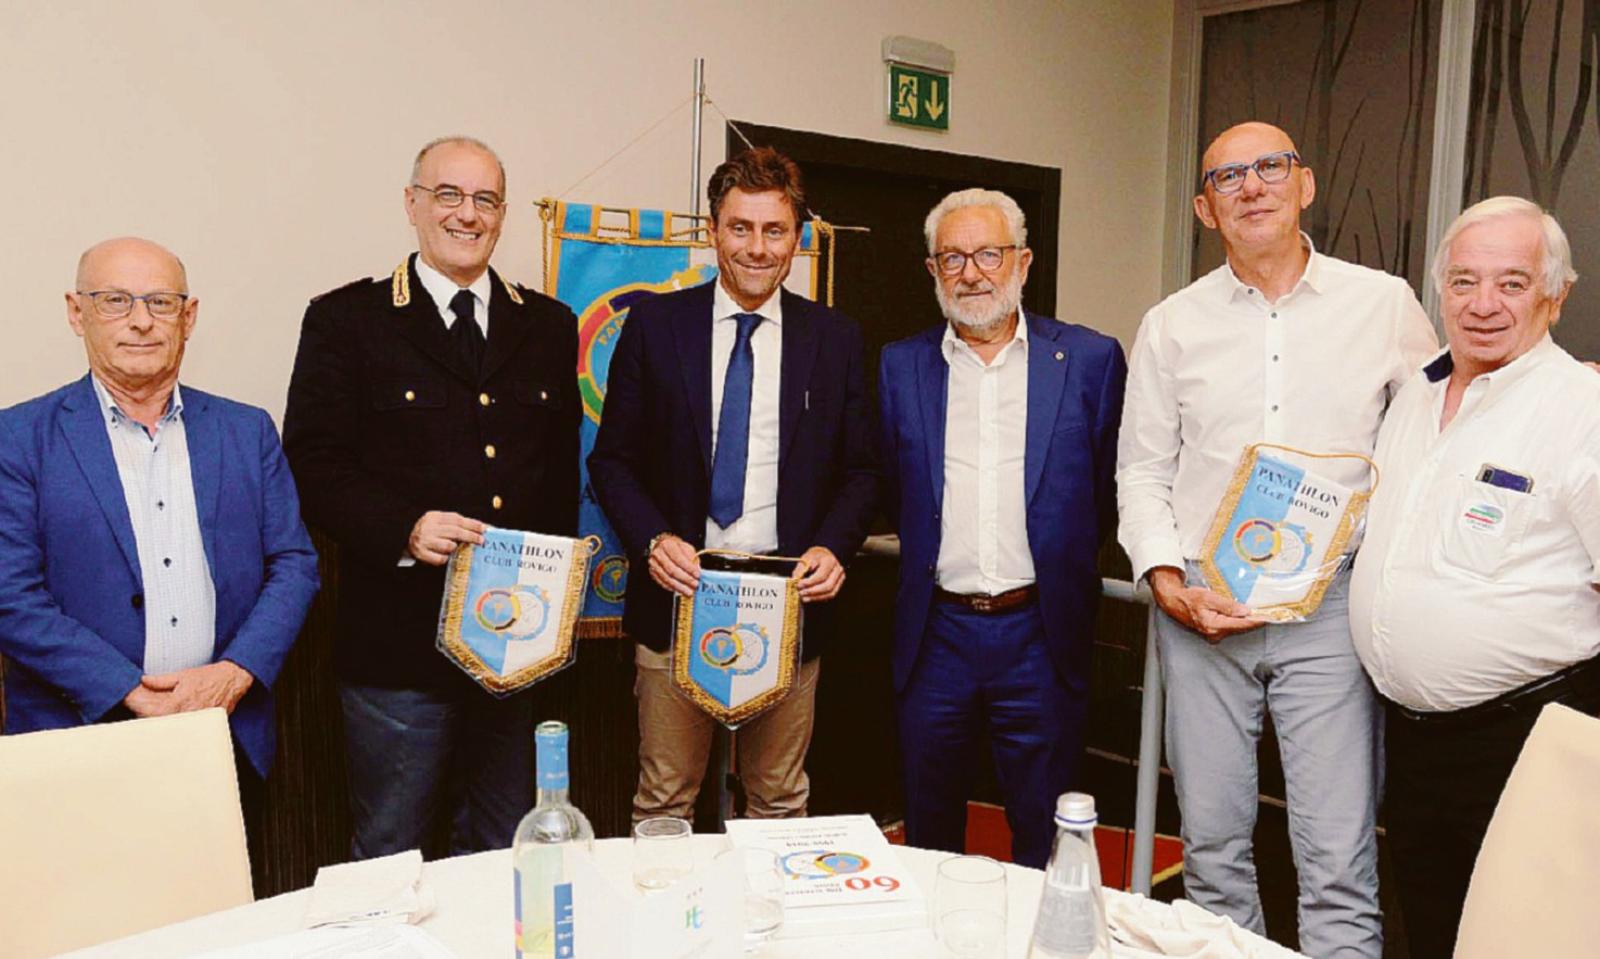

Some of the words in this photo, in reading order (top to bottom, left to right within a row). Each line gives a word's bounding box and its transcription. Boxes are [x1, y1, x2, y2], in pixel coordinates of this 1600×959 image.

[1258, 466, 1340, 507] PANATHLON
[1287, 495, 1330, 519] ROVIGO
[481, 540, 565, 559] PANATHLON
[483, 555, 512, 568] CLUB
[517, 560, 557, 573] ROVIGO
[701, 582, 779, 598] PANATHLON
[704, 598, 731, 608] CLUB
[735, 601, 775, 611] ROVIGO
